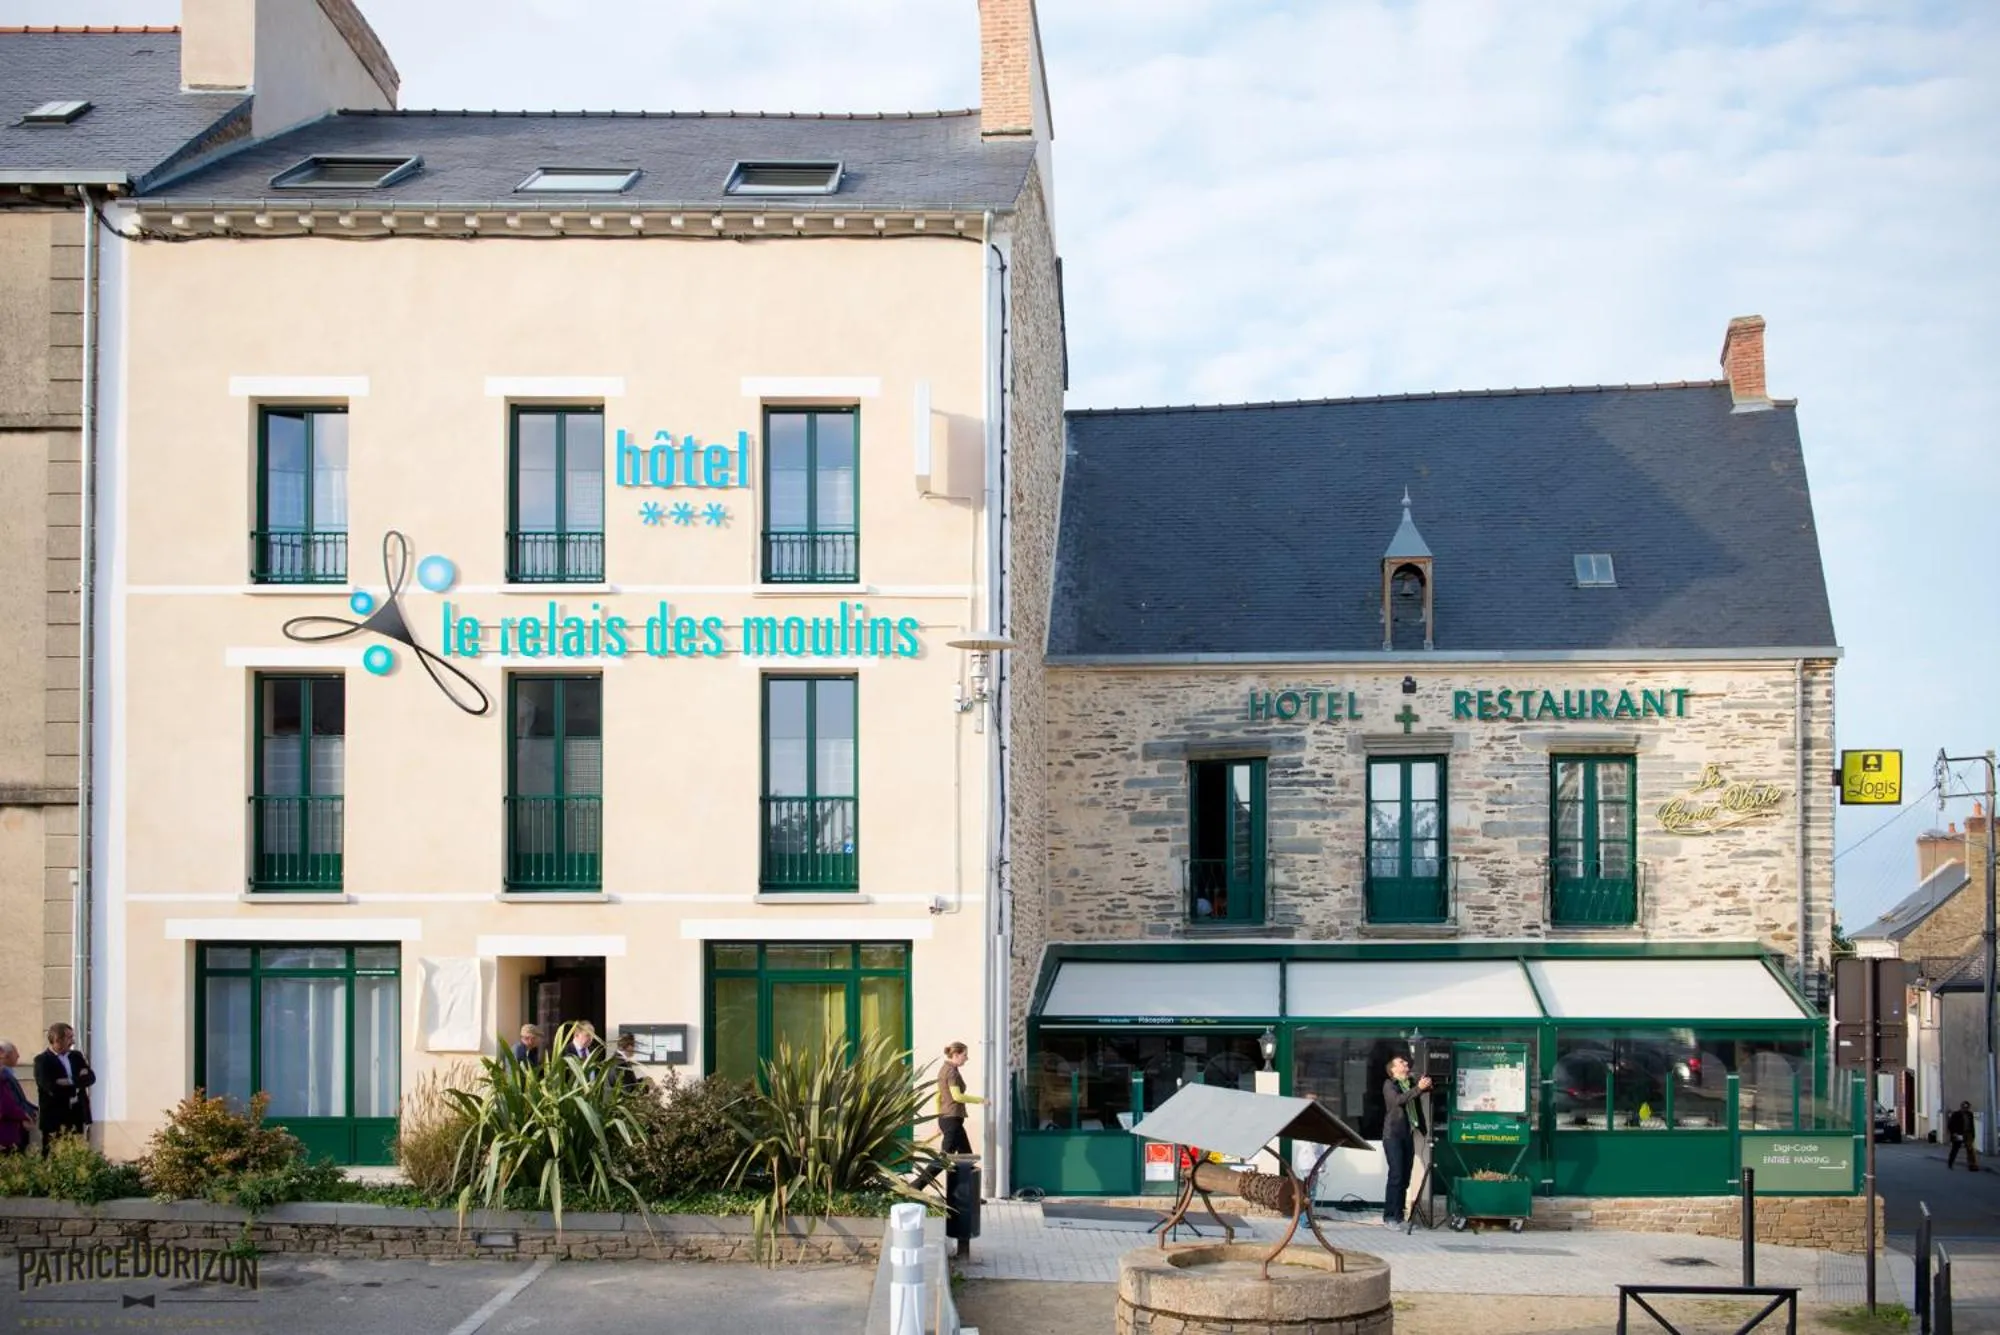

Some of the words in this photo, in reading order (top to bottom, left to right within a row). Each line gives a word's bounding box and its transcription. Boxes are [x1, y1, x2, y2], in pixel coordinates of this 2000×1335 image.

[617, 429, 748, 488] hôtel
[443, 601, 480, 657] le
[501, 601, 627, 657] relais
[646, 601, 723, 657] des
[743, 601, 919, 657] moulins
[1249, 690, 1363, 720] HOTEL
[1452, 688, 1689, 720] RESTAURANT
[1847, 774, 1897, 798] Logis
[1773, 1143, 1819, 1152] Digi-Code
[1794, 1156, 1830, 1164] PARKING
